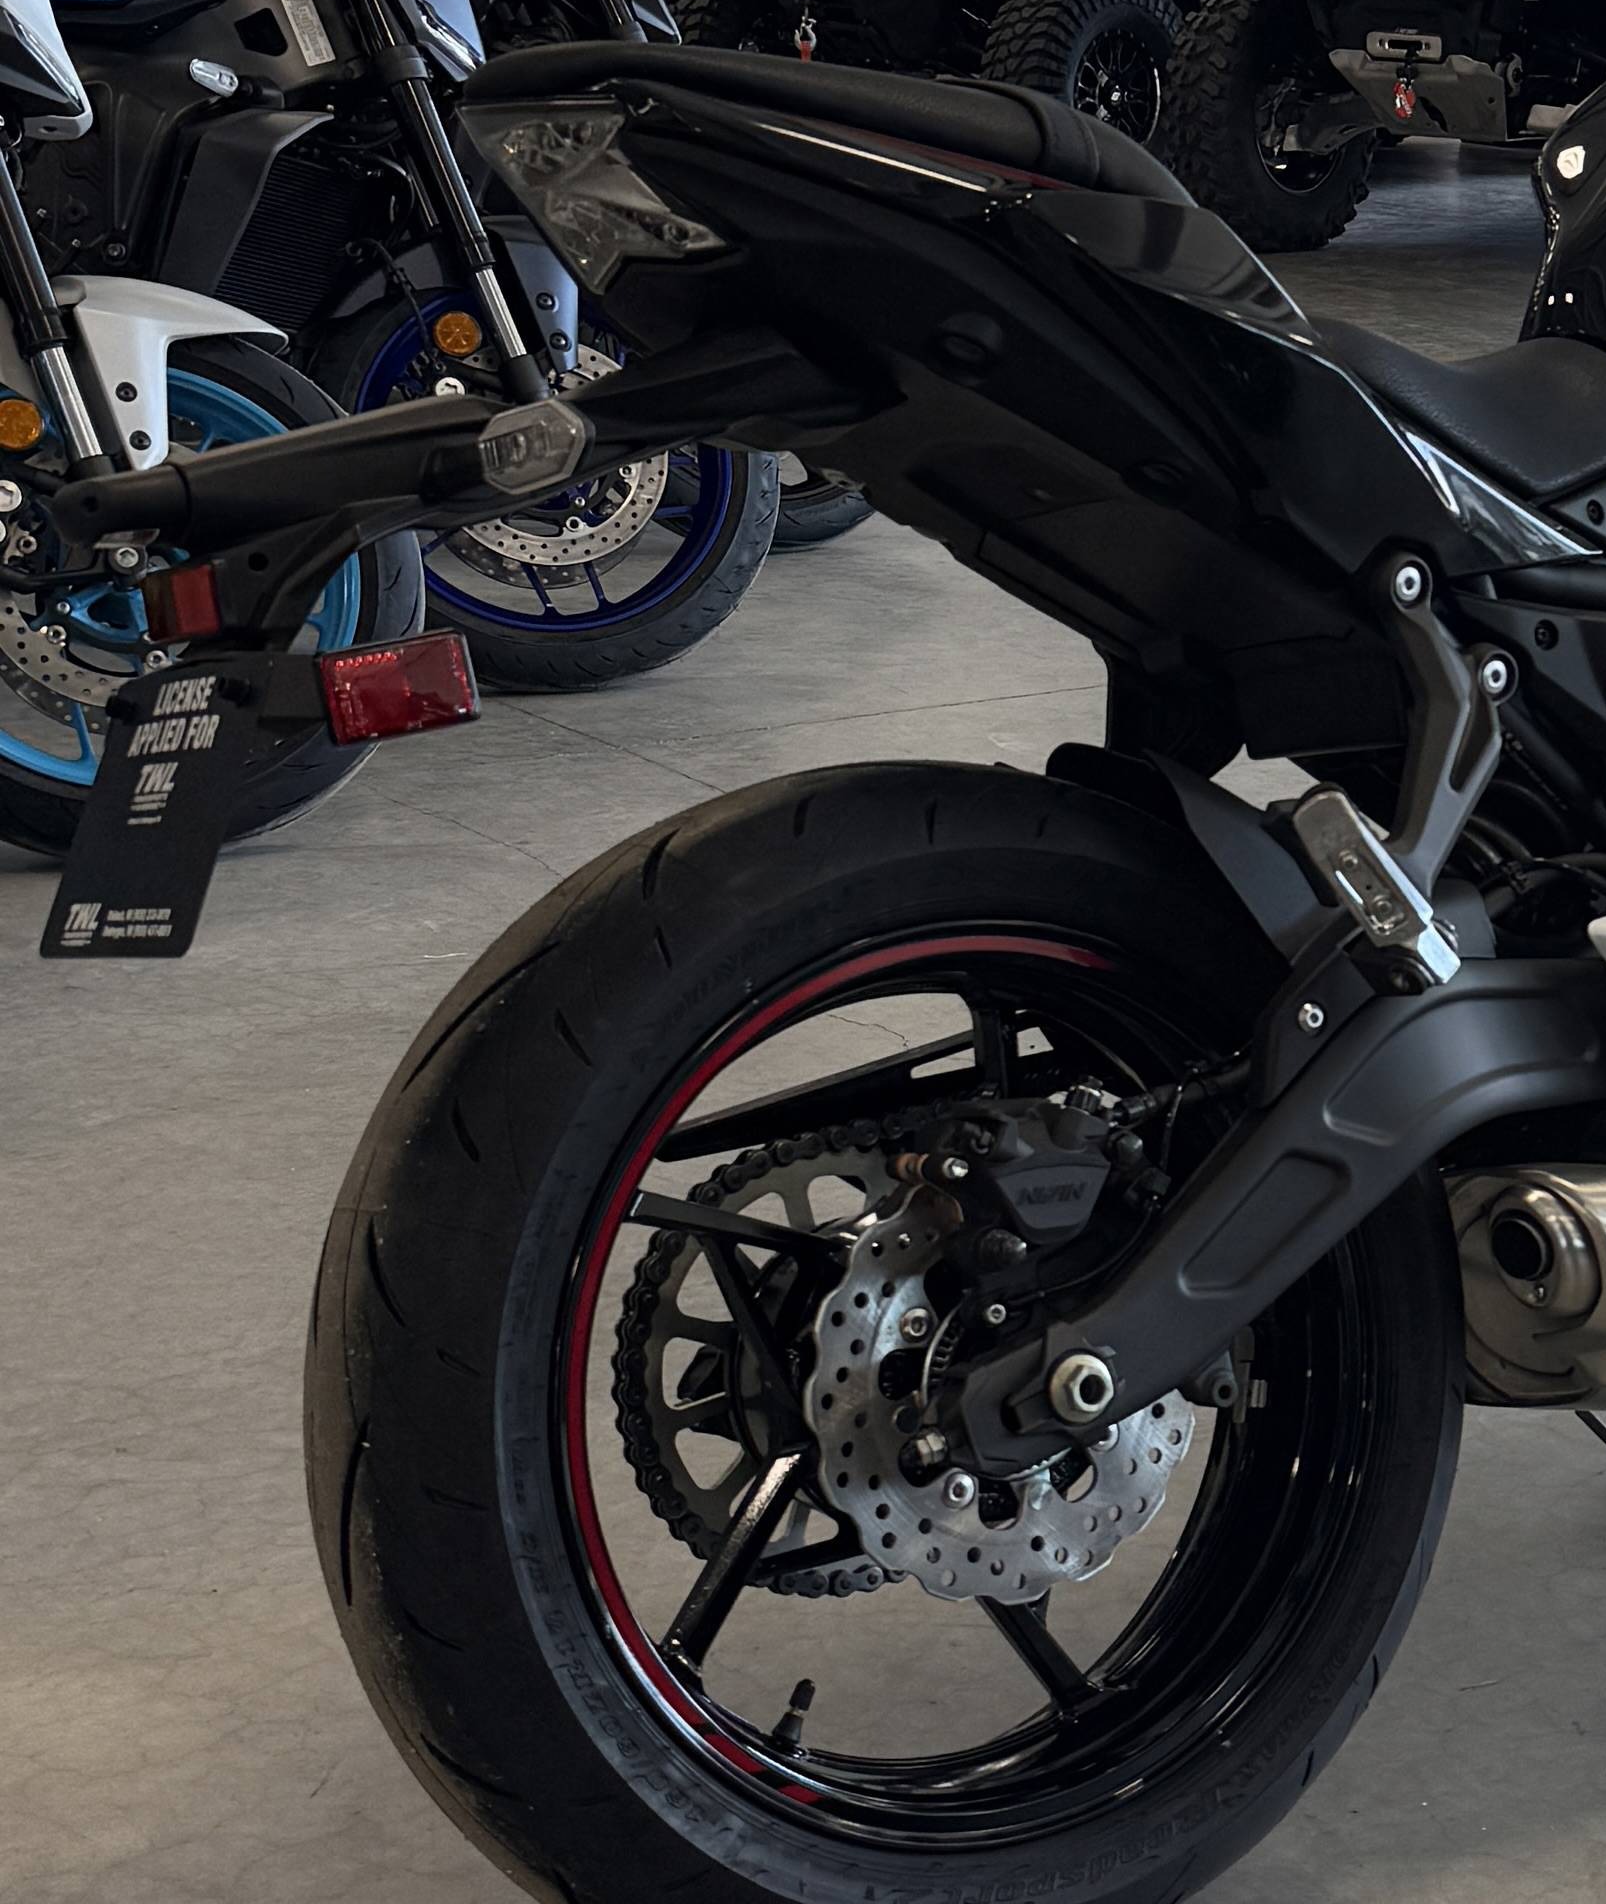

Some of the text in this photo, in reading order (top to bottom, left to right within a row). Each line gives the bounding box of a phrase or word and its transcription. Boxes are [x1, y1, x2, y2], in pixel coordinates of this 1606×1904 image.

[152, 676, 217, 716] LICENSE
[127, 714, 220, 758] APPLIED FOR
